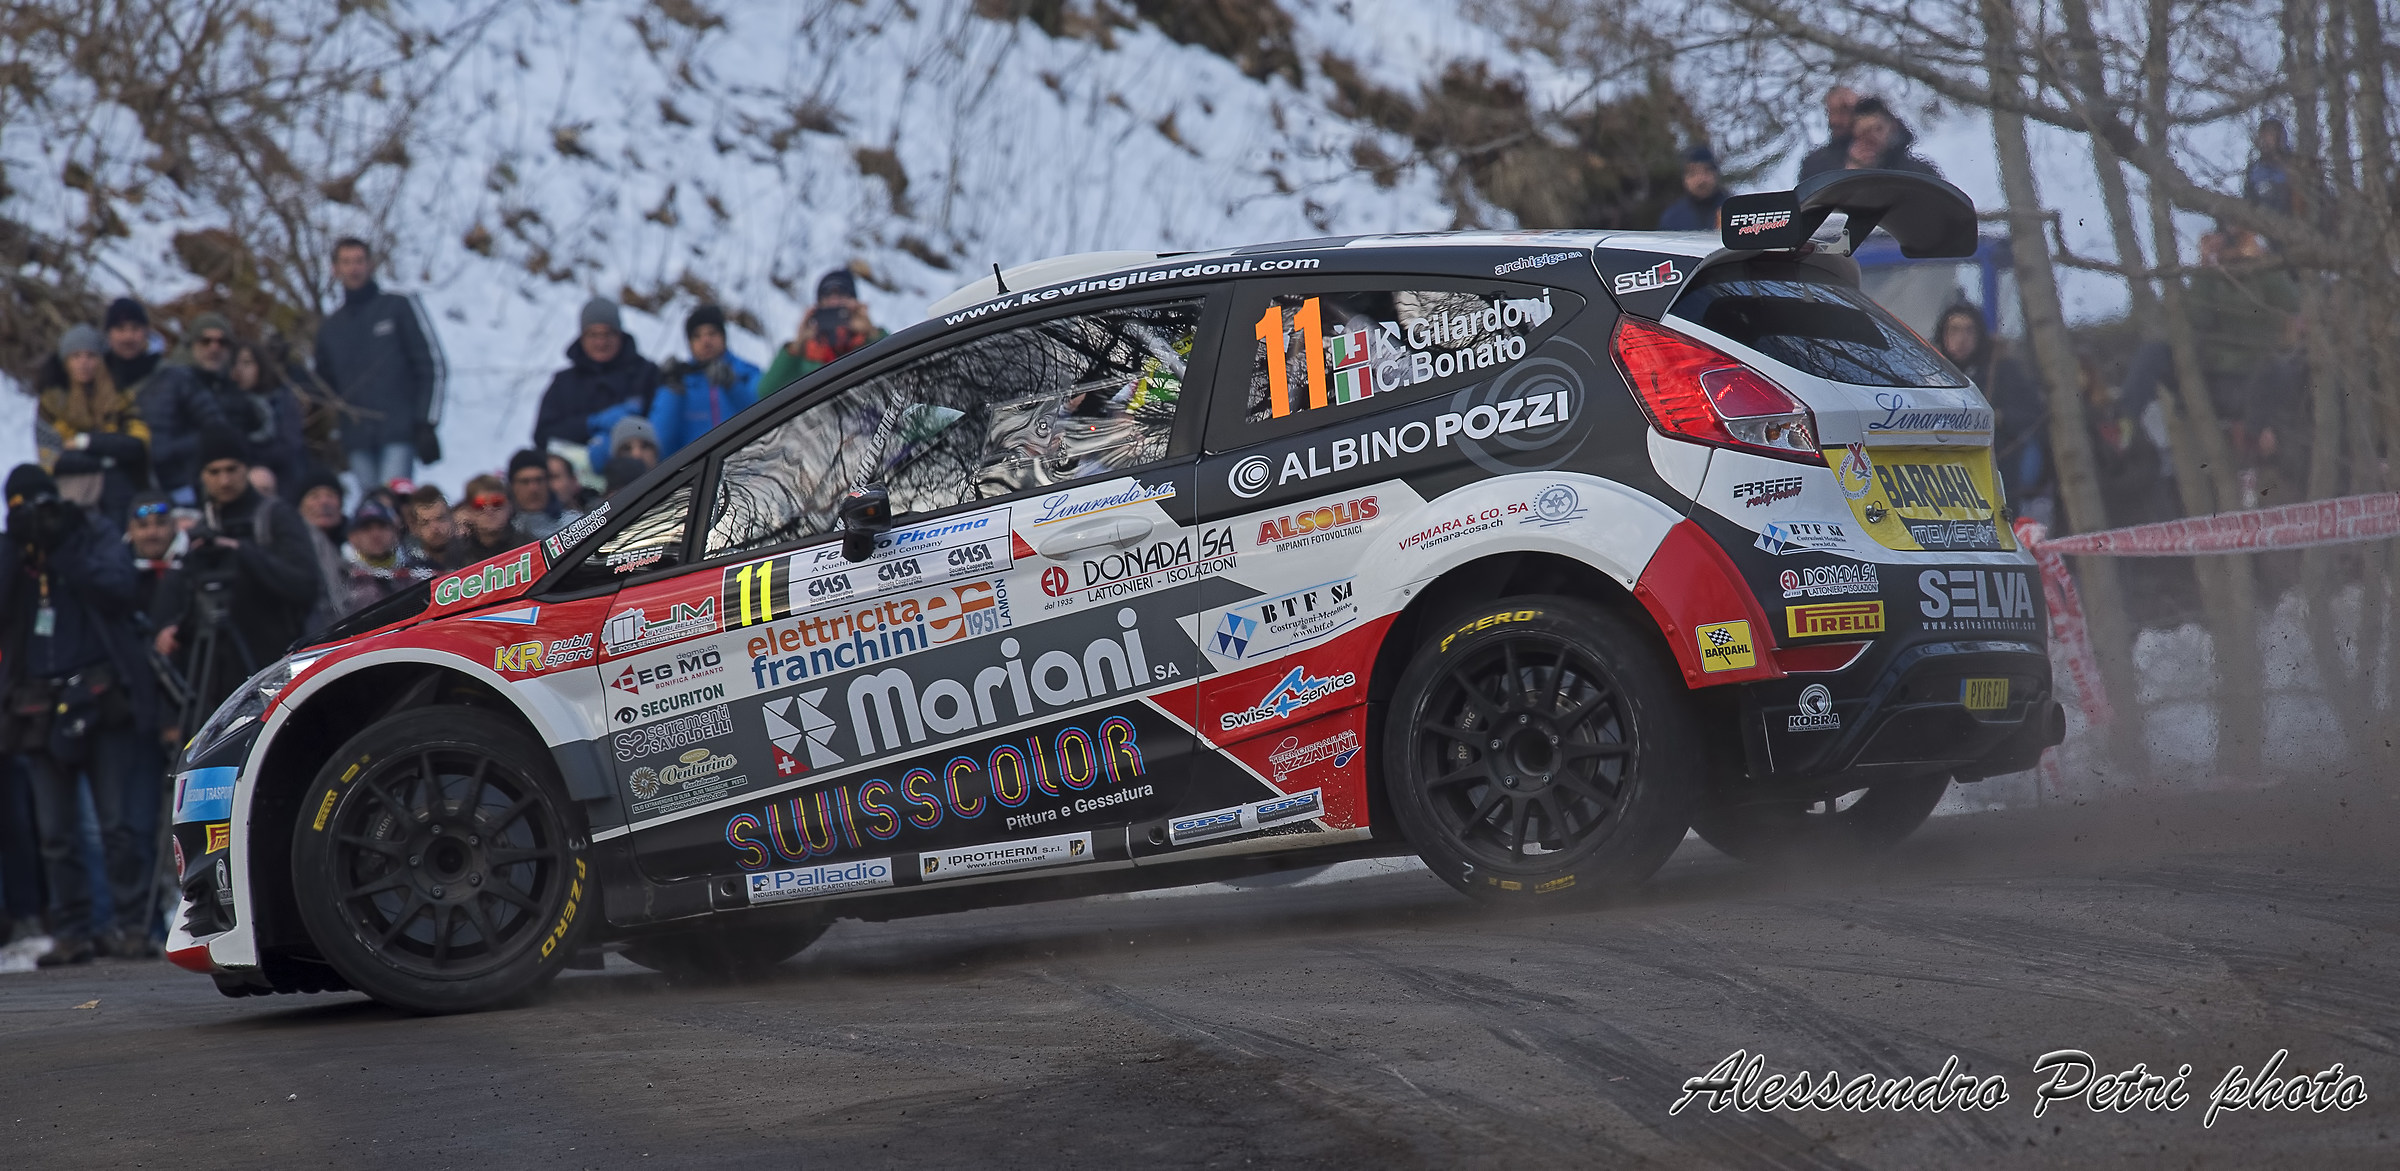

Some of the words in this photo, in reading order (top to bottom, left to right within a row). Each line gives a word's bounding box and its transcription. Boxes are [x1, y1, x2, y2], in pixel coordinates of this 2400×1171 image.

[1494, 252, 1567, 276] archigiga
[1616, 261, 1682, 292] Stilo
[944, 256, 1320, 326] www.kevingilardoni.com
[1255, 297, 1328, 419] 11
[1376, 336, 1526, 393] C.Bonato
[1869, 393, 1973, 430] Linarredo
[1034, 480, 1141, 524] Linarredo
[1874, 464, 1992, 517] BARDAHL
[895, 518, 989, 546] Pharma
[1257, 496, 1380, 546] ALSOLIS
[1399, 518, 1462, 551] VISMARA
[1466, 514, 1476, 525] &
[1480, 508, 1503, 521] CO.
[1508, 502, 1529, 515] SA
[1421, 518, 1504, 551] vismara-cosa.ch
[899, 540, 943, 555] Company
[1276, 538, 1310, 553] IMPIANTI
[1311, 525, 1362, 545] FOTOVOLTAICI
[1083, 536, 1191, 586] DONADA
[1202, 526, 1235, 558] SA
[435, 553, 531, 606] Gehri
[1087, 575, 1153, 602] LATTONIERI
[1166, 556, 1238, 584] ISOLAZIONI
[1803, 564, 1860, 587] DONADA
[1862, 563, 1877, 582] SA
[736, 561, 773, 627] 11
[998, 578, 1012, 627] LAMON
[1044, 601, 1055, 611] dal
[1056, 598, 1074, 608] 1935
[1331, 581, 1353, 605] SA
[1918, 569, 2035, 618] SELVA
[966, 607, 1000, 636] 1951
[1270, 614, 1316, 634] Costruzioni
[1794, 603, 1880, 634] PIRELLI
[494, 641, 544, 672] KR
[545, 648, 593, 667] sport
[550, 633, 593, 654] publi
[676, 644, 718, 660] degmo.ch
[752, 614, 928, 690] franchini
[1705, 644, 1751, 660] BARDAHL
[655, 677, 688, 689] BONIFICA
[691, 666, 724, 680] AMIANTO
[678, 651, 721, 674] MO
[846, 607, 1151, 756] Mariani
[1153, 662, 1181, 682] SA
[641, 683, 725, 717] SECURITON
[1222, 706, 1275, 730] Swiss
[1300, 673, 1355, 706] service
[648, 704, 731, 739] serramenti
[1788, 713, 1840, 727] KOBRA
[651, 719, 733, 753] SAVOLDELLI
[660, 755, 736, 784] Venturino
[1273, 734, 1359, 777] AZZALINI
[725, 715, 1146, 871] SWISSCOLOR
[1006, 808, 1057, 830] Pittura
[1061, 805, 1071, 817] e
[1075, 784, 1154, 813] Gessatura
[1257, 795, 1313, 815] GPS
[1174, 812, 1236, 831] GPS
[948, 846, 1038, 868] IDROTHERM
[966, 854, 1046, 870] www.idrotherm.net
[753, 889, 785, 899] INDUSTRIE
[787, 886, 820, 895] GRAFICHE
[821, 879, 877, 891] CARTOTECNICHE
[775, 863, 887, 889] Palladio
